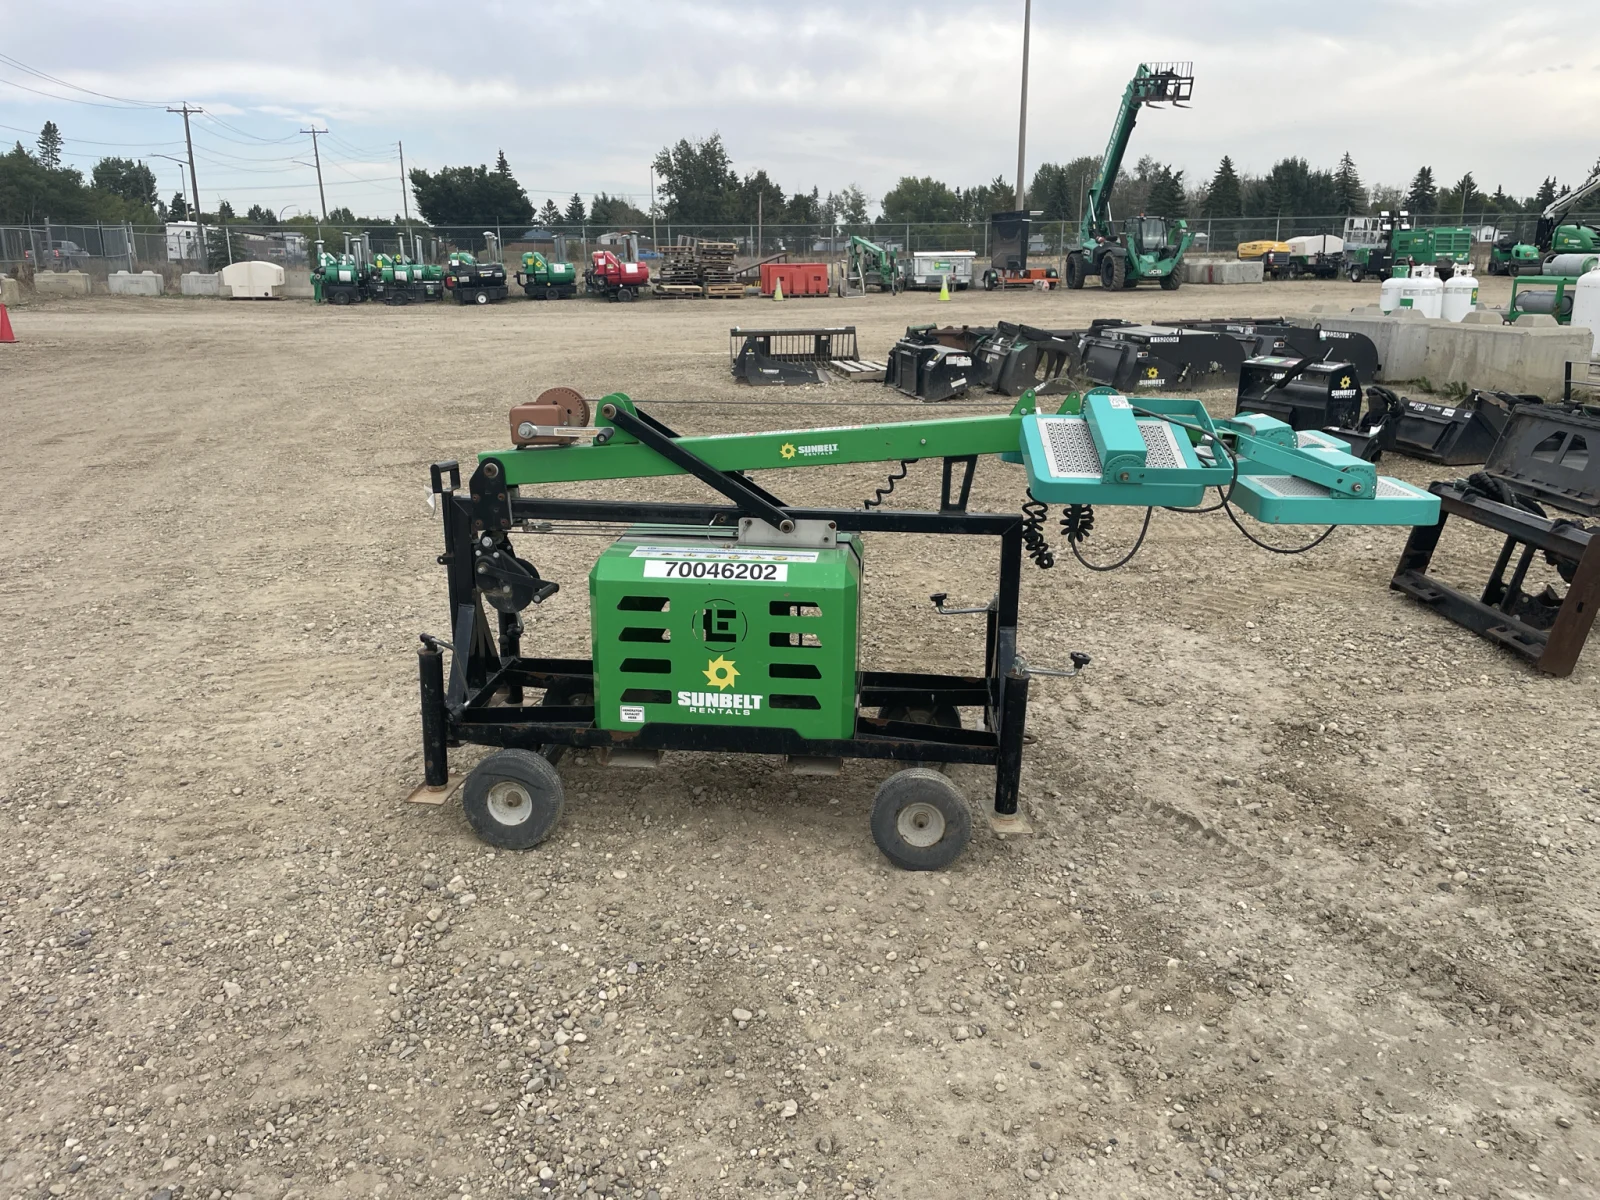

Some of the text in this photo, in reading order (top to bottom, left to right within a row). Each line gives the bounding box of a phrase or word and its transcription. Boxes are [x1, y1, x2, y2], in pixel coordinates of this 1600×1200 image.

[798, 444, 838, 453] SUNBELT
[665, 561, 777, 580] 70046202
[678, 691, 763, 709] SUNBELT
[690, 707, 750, 716] RENTALS
